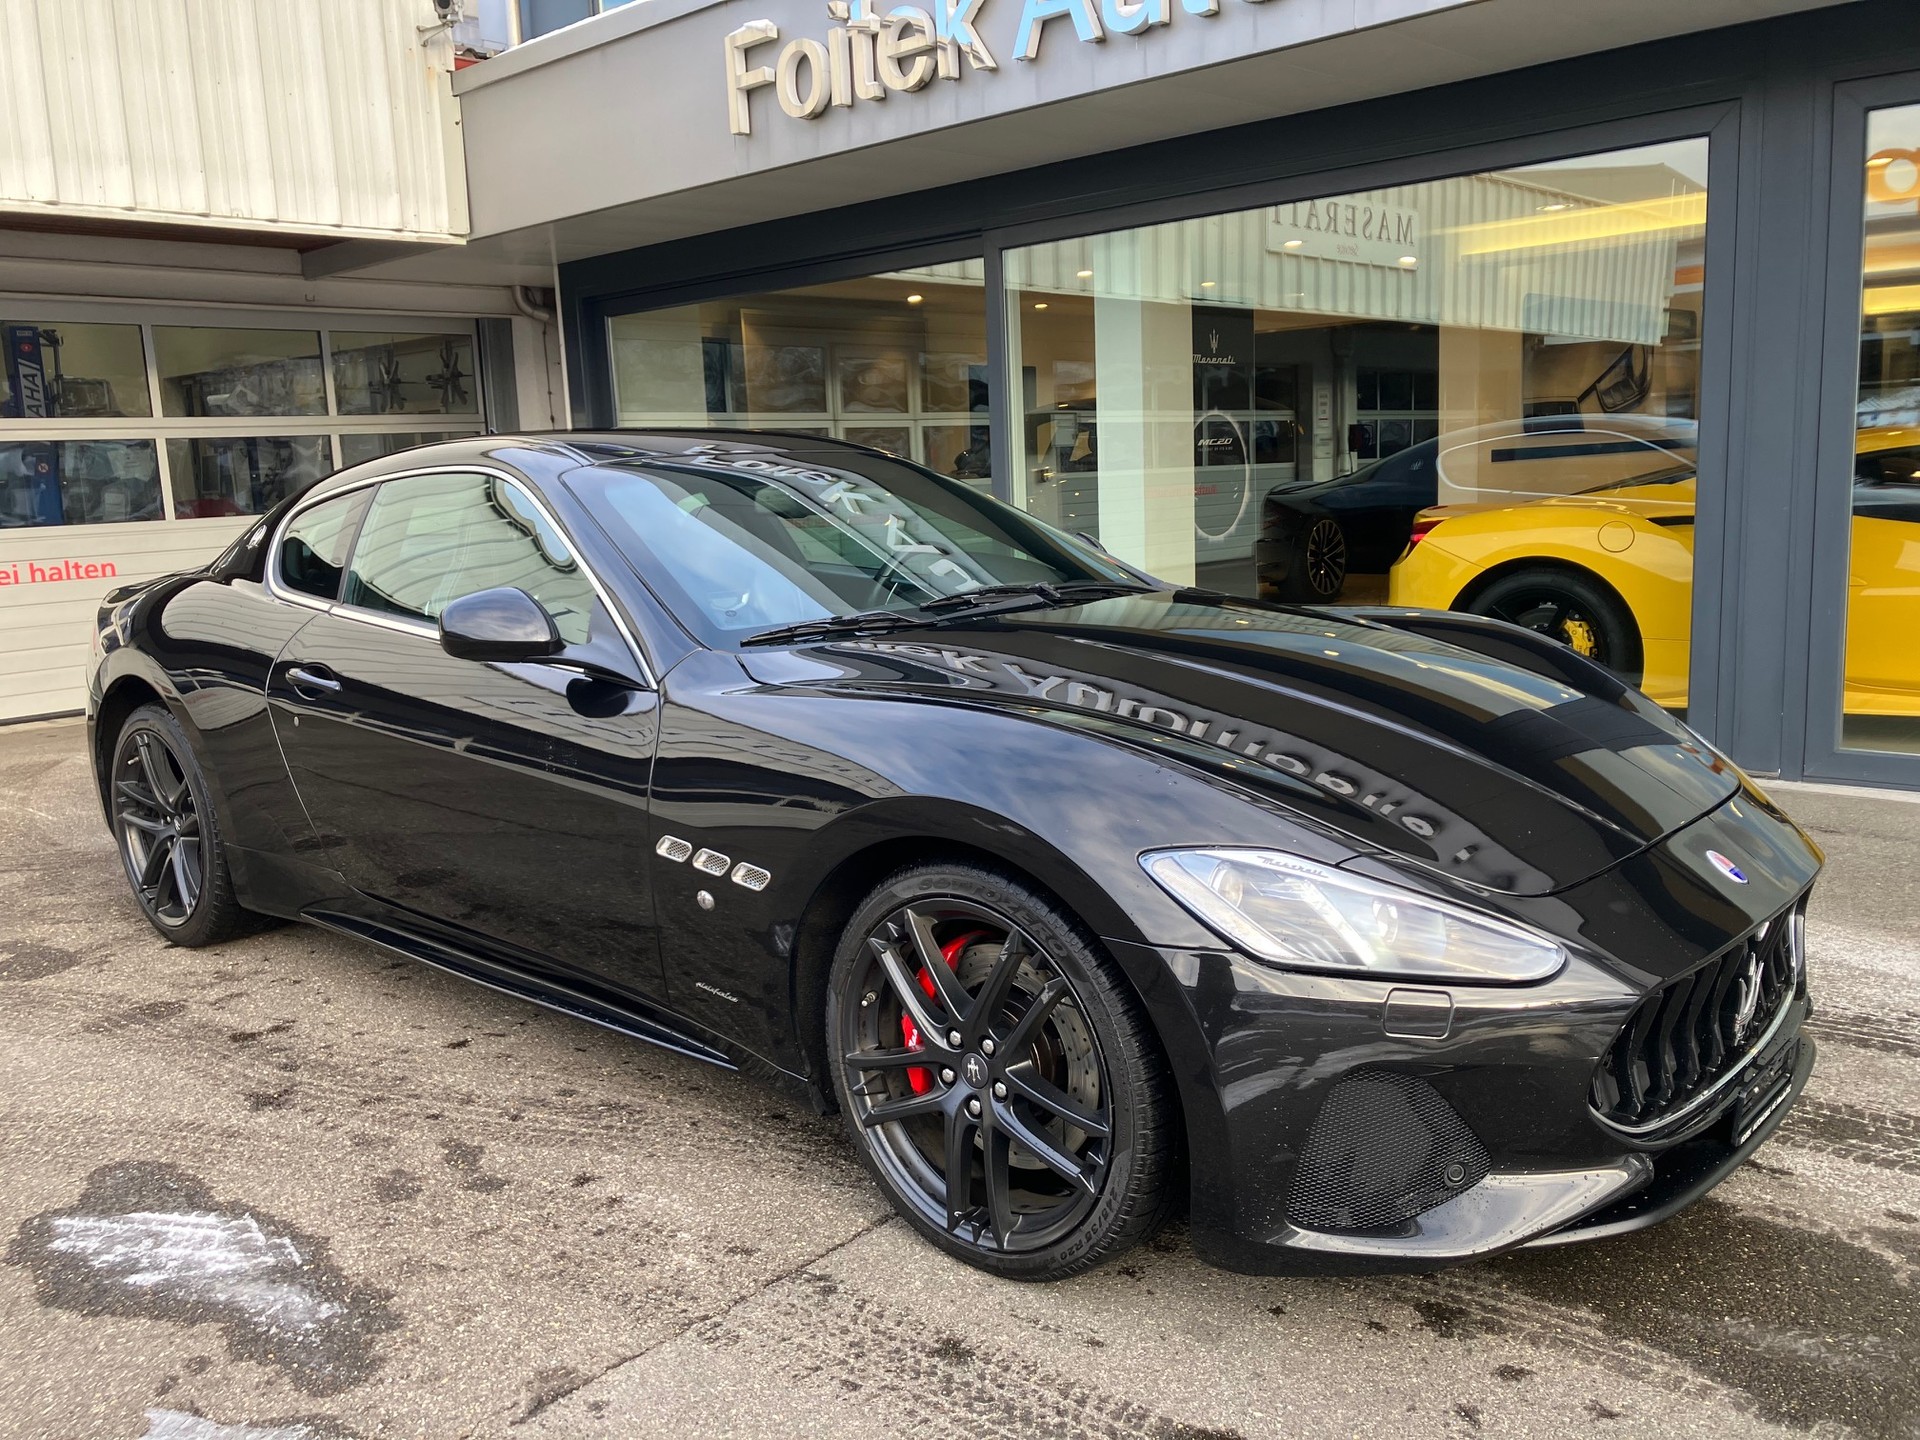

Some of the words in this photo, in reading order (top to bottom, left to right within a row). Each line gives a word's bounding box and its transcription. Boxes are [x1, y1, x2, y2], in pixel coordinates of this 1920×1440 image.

[724, 0, 997, 135] Foitek
[1193, 354, 1236, 365] Maserati
[1197, 438, 1233, 446] MC20
[29, 560, 117, 583] halten
